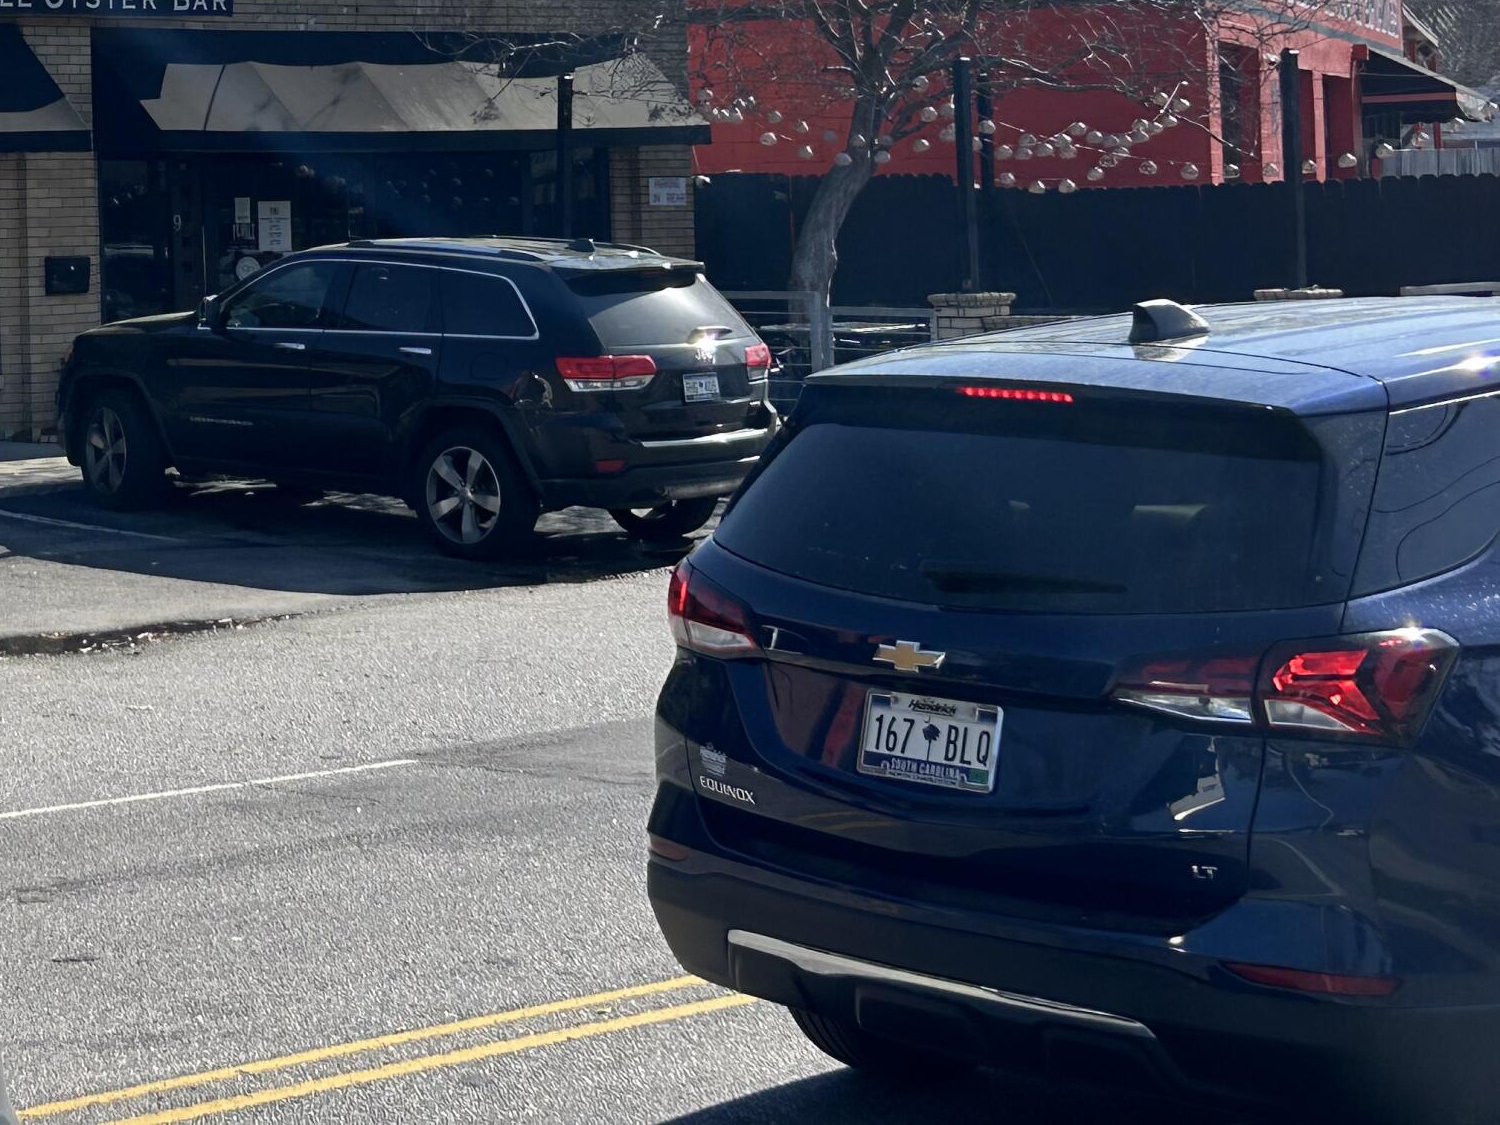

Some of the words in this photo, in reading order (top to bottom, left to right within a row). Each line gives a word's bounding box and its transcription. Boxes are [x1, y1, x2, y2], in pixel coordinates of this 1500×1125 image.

[874, 714, 916, 755] 167
[943, 723, 991, 767] BLQ
[890, 757, 918, 774] SOUTH
[918, 761, 961, 779] CAROLINA
[699, 775, 756, 805] EQUINOX
[1191, 865, 1218, 880] LT
